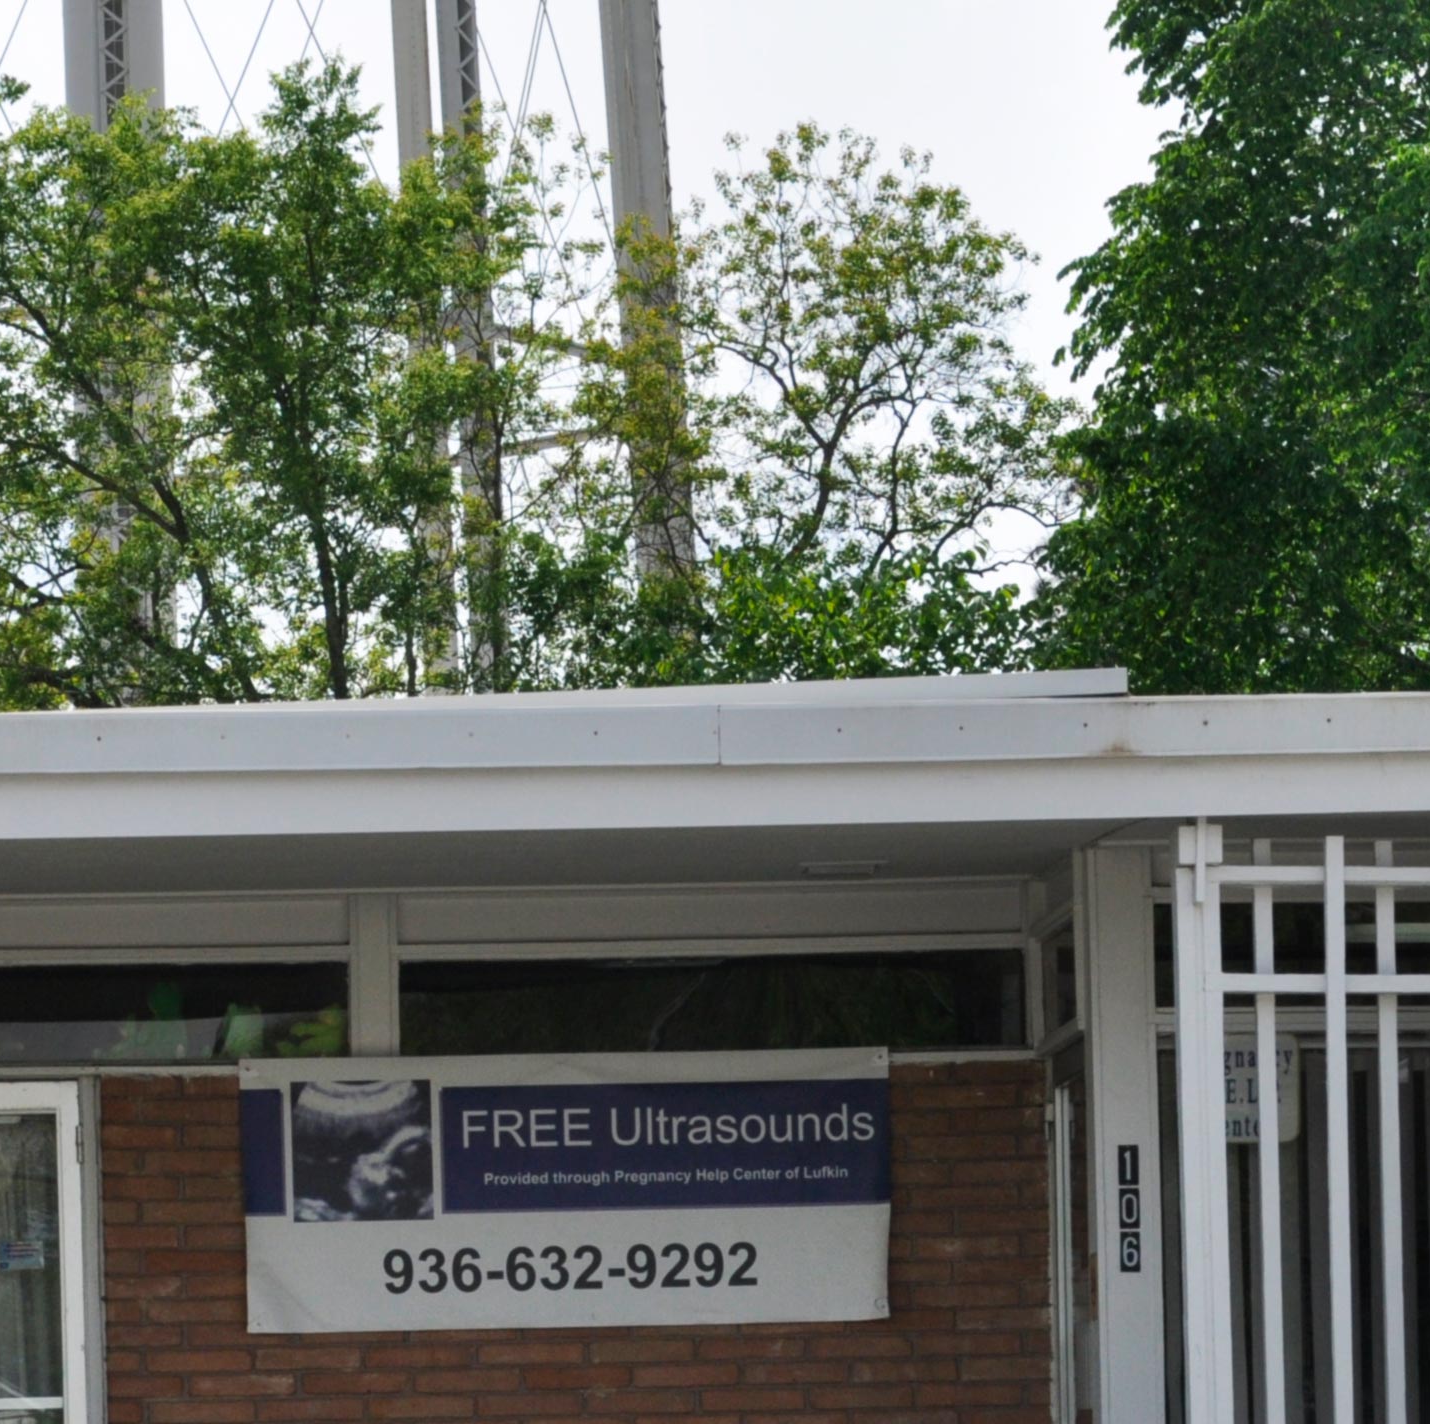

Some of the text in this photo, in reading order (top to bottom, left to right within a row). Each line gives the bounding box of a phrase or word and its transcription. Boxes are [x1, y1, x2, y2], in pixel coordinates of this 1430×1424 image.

[461, 1103, 876, 1149] FREE Ultrasounds
[483, 1164, 849, 1187] Provided through Pregnancy Help Center of Lufkin
[1122, 1150, 1139, 1267] 106
[382, 1241, 758, 1295] 936-632-9292
